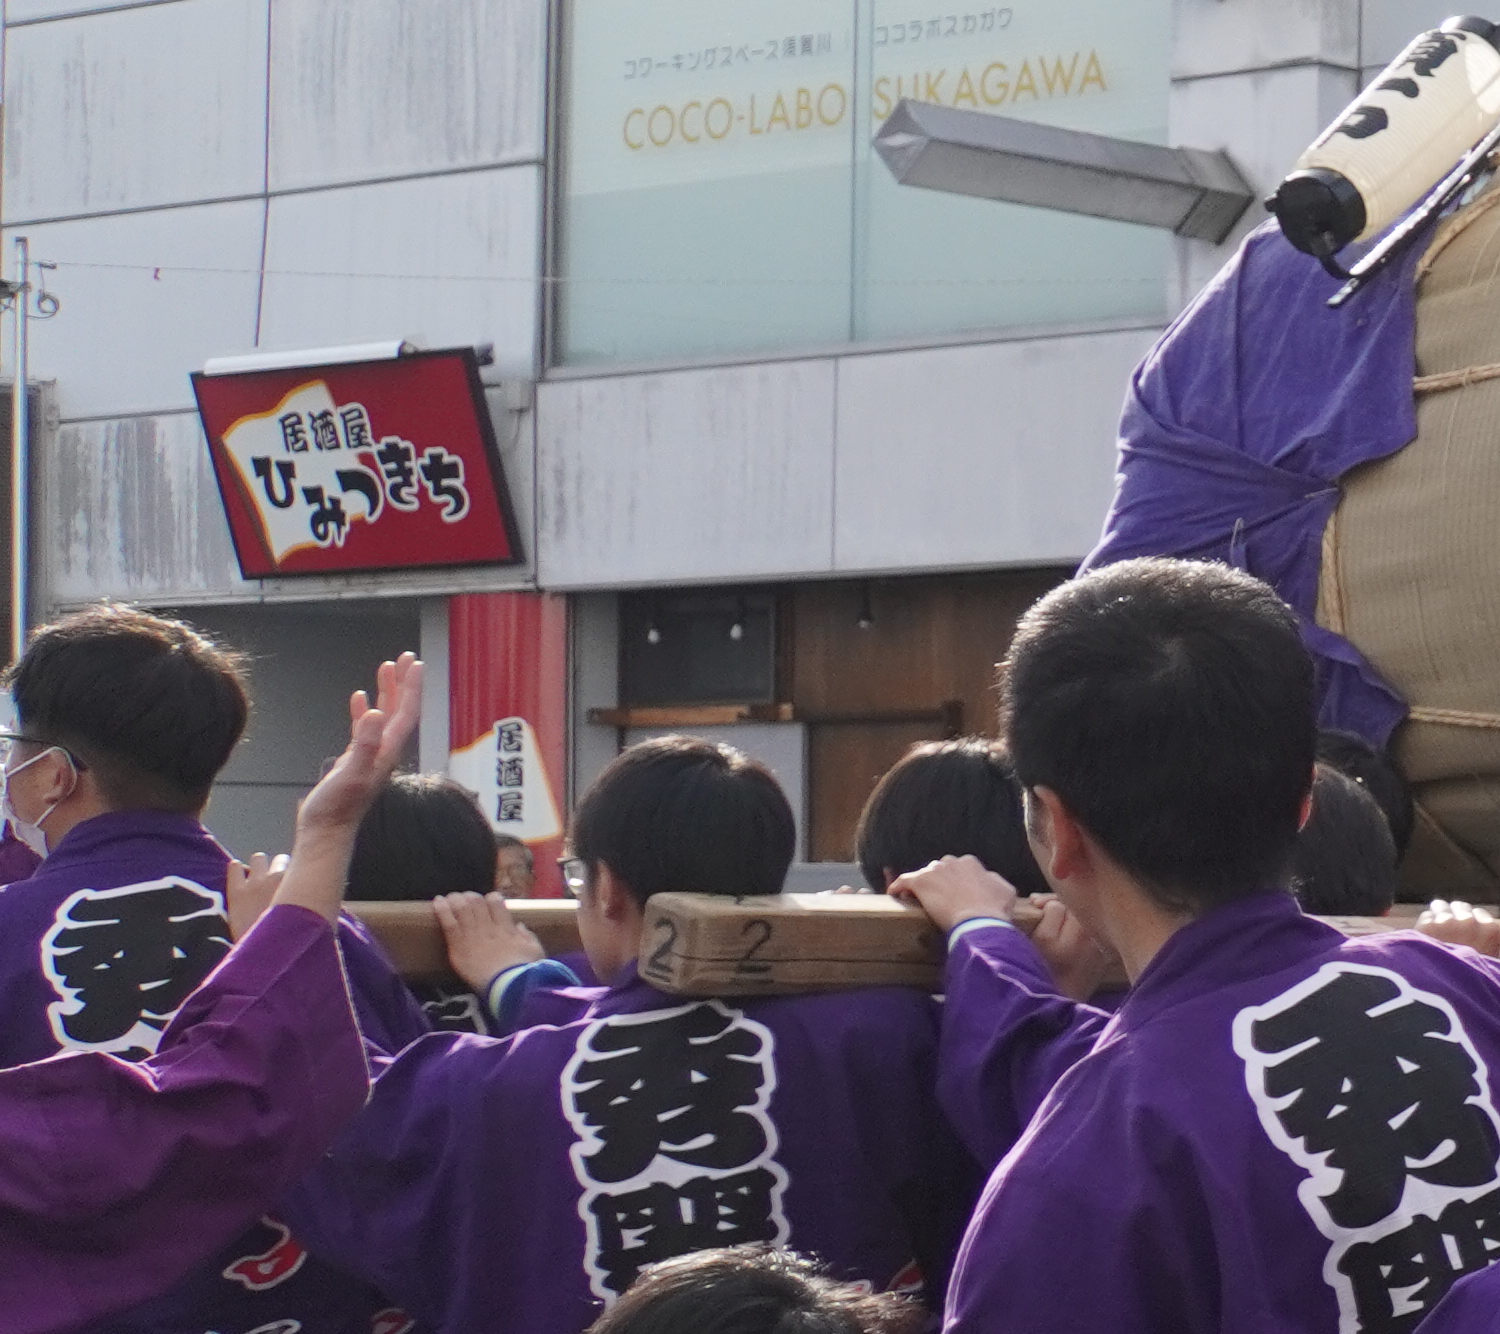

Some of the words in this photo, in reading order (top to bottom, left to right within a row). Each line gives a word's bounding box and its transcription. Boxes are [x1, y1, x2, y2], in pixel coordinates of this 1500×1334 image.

[622, 83, 847, 150] COCO-LABO
[279, 404, 373, 454] 居酒屋
[251, 437, 468, 546] ひみつきち
[496, 721, 523, 823] 居酒屋
[647, 917, 678, 974] 2
